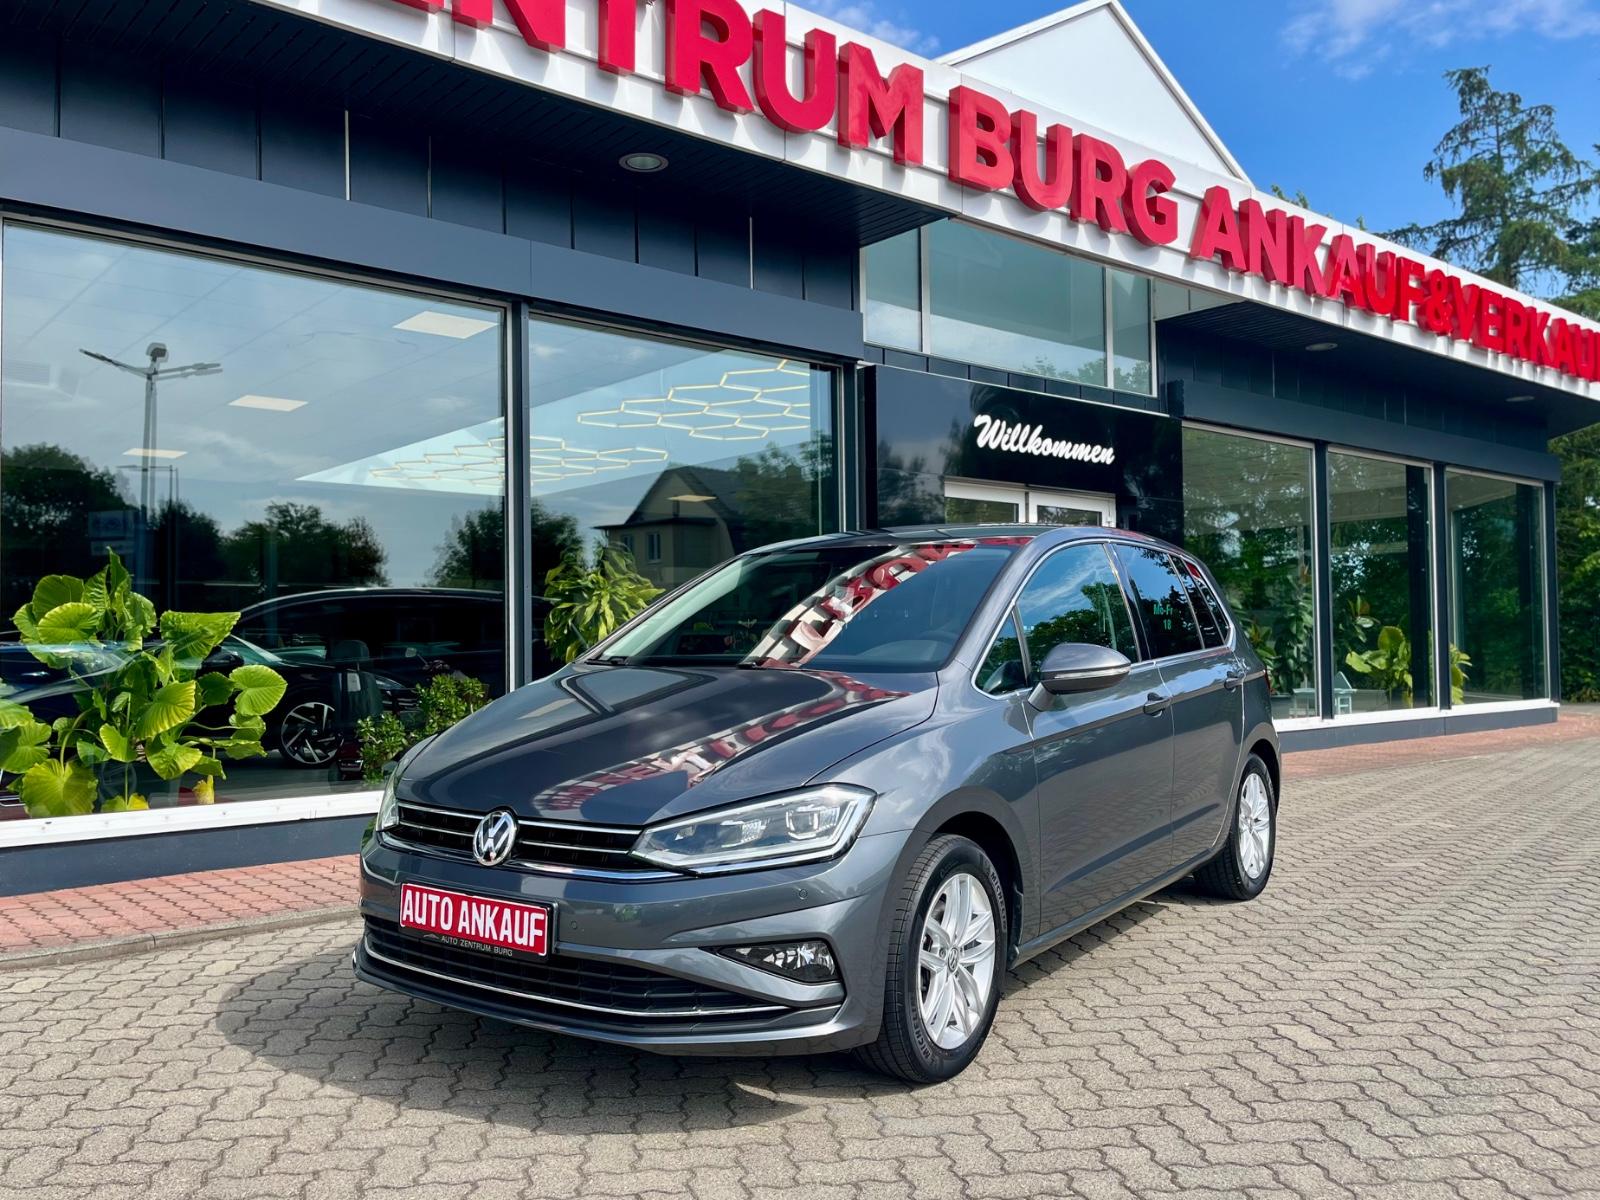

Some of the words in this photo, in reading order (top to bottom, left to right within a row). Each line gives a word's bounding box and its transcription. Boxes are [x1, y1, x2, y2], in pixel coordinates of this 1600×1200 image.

[948, 84, 1178, 246] BURG
[1190, 185, 1600, 383] ANKAUF&VERKAU
[973, 413, 1115, 465] Willkommen
[402, 889, 453, 931] AUTO
[457, 900, 545, 947] ANKAUF
[441, 935, 458, 945] AUTO
[460, 939, 491, 952] ZENTRUM
[494, 946, 513, 957] BURG
